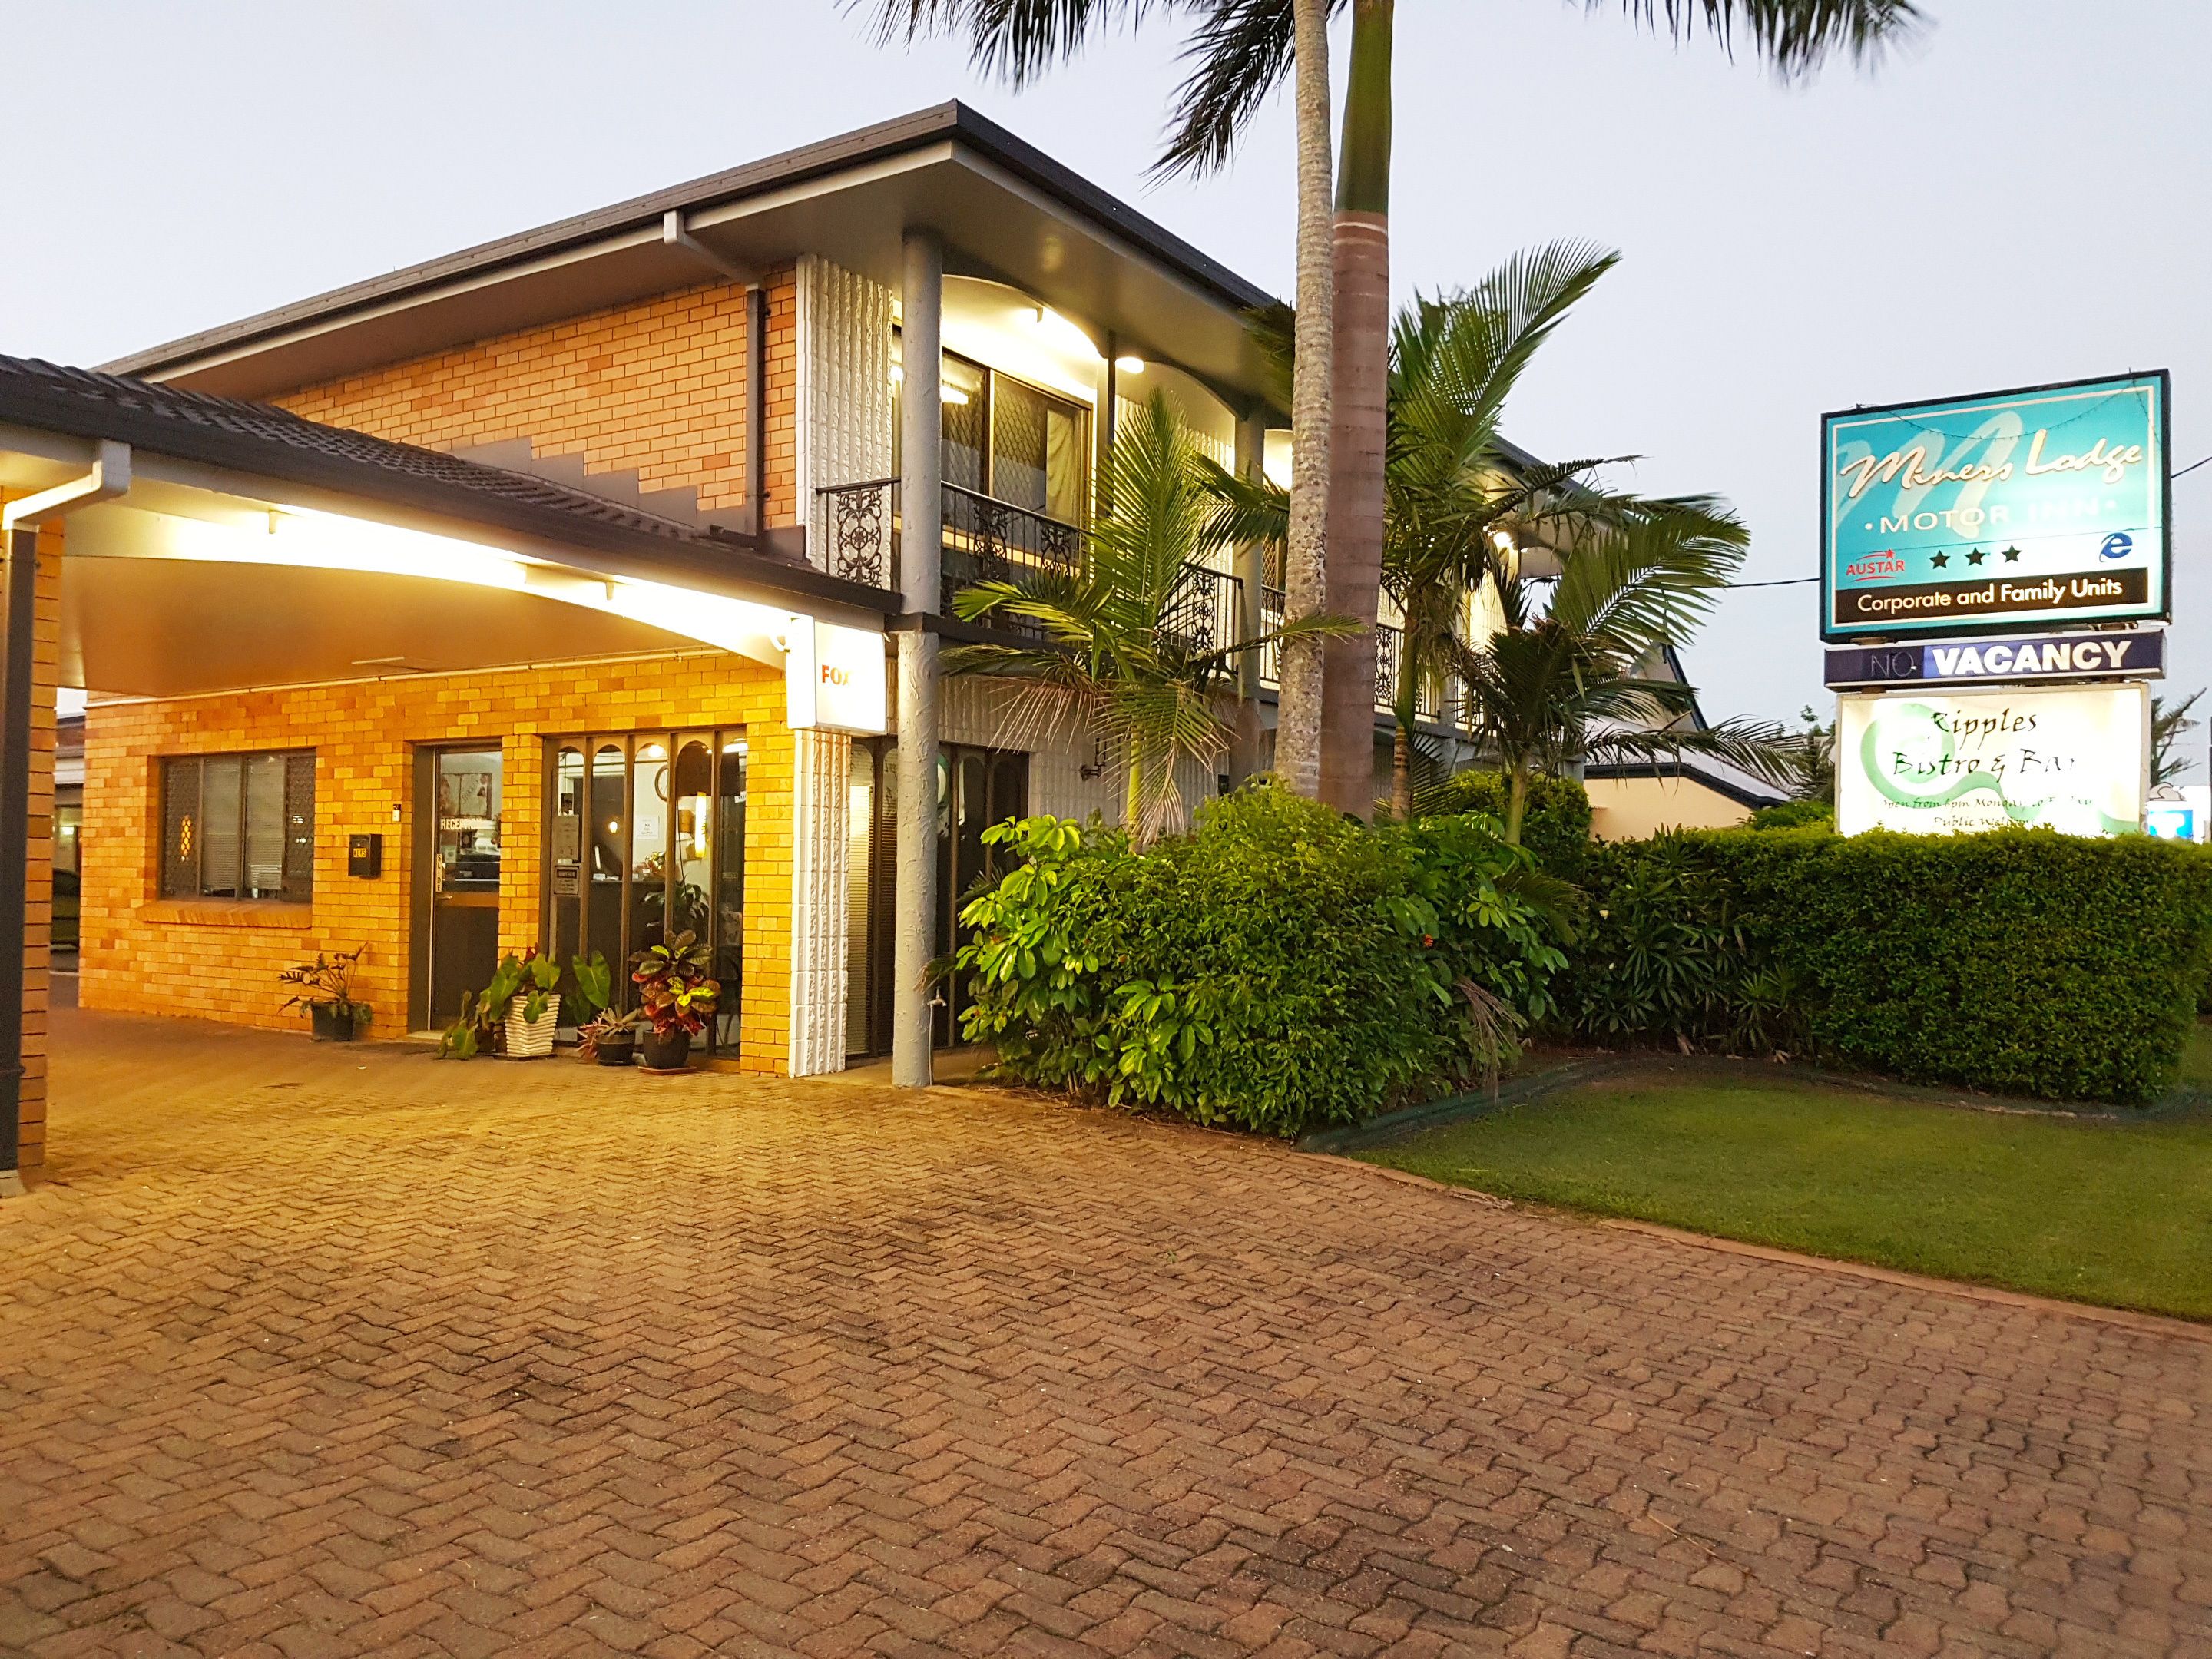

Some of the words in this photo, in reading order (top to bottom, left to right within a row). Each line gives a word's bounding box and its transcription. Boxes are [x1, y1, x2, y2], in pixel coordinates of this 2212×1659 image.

[1840, 445, 2014, 498] Miners
[2025, 429, 2142, 484] Lodge
[1880, 505, 2010, 535] MOTOR
[2027, 497, 2099, 522] INN
[1846, 558, 1906, 576] AUSTAR
[1857, 594, 1952, 615] Corporate
[1956, 583, 1995, 605] and
[2000, 578, 2066, 605] Family
[2071, 578, 2124, 598] Units
[1870, 651, 1916, 678] NO
[1932, 640, 2133, 677] VACANCY
[1930, 707, 2037, 750] Ripples
[1892, 751, 1981, 776] Bistro
[1990, 753, 2007, 783] &
[1883, 800, 1910, 808] pen
[1912, 797, 1942, 809] from
[1934, 814, 1975, 826] Public
